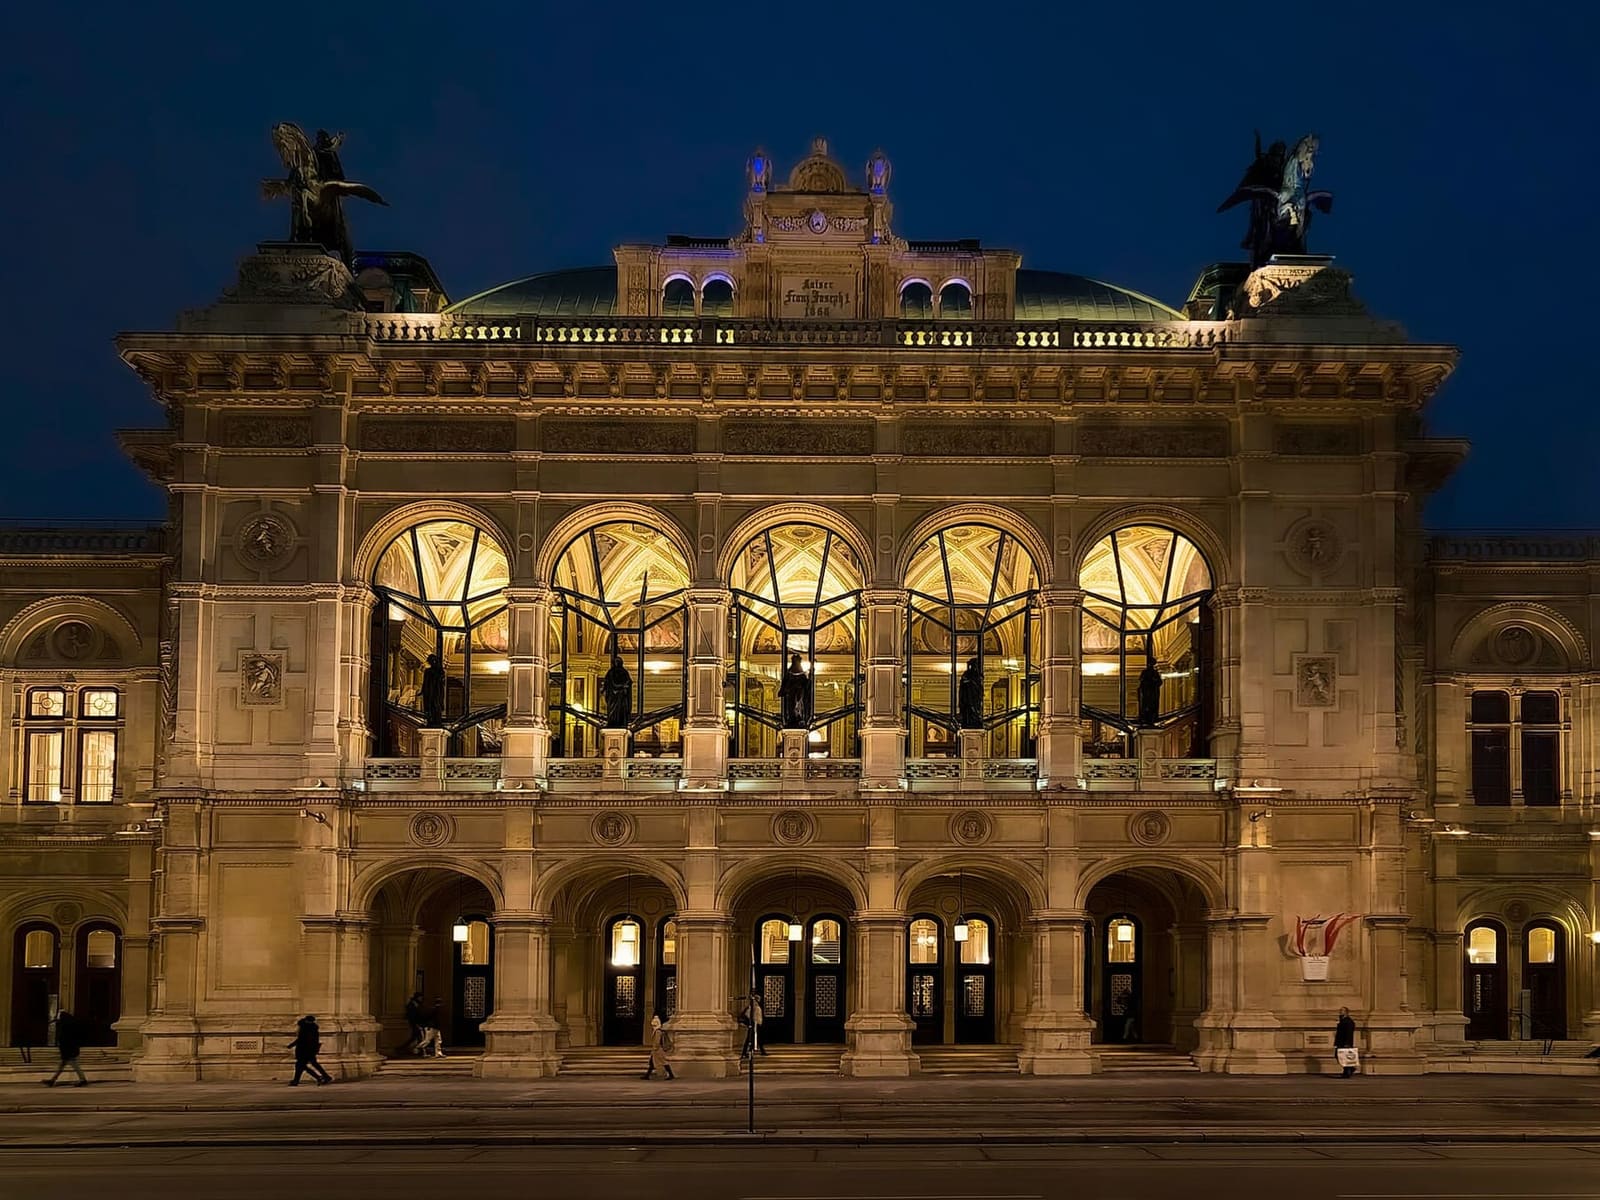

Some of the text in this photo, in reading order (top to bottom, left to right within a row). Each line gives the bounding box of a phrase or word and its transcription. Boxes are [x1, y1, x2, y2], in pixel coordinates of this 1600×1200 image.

[800, 279, 834, 290] Kaiser
[784, 290, 810, 305] Franz
[811, 290, 843, 308] Joseph
